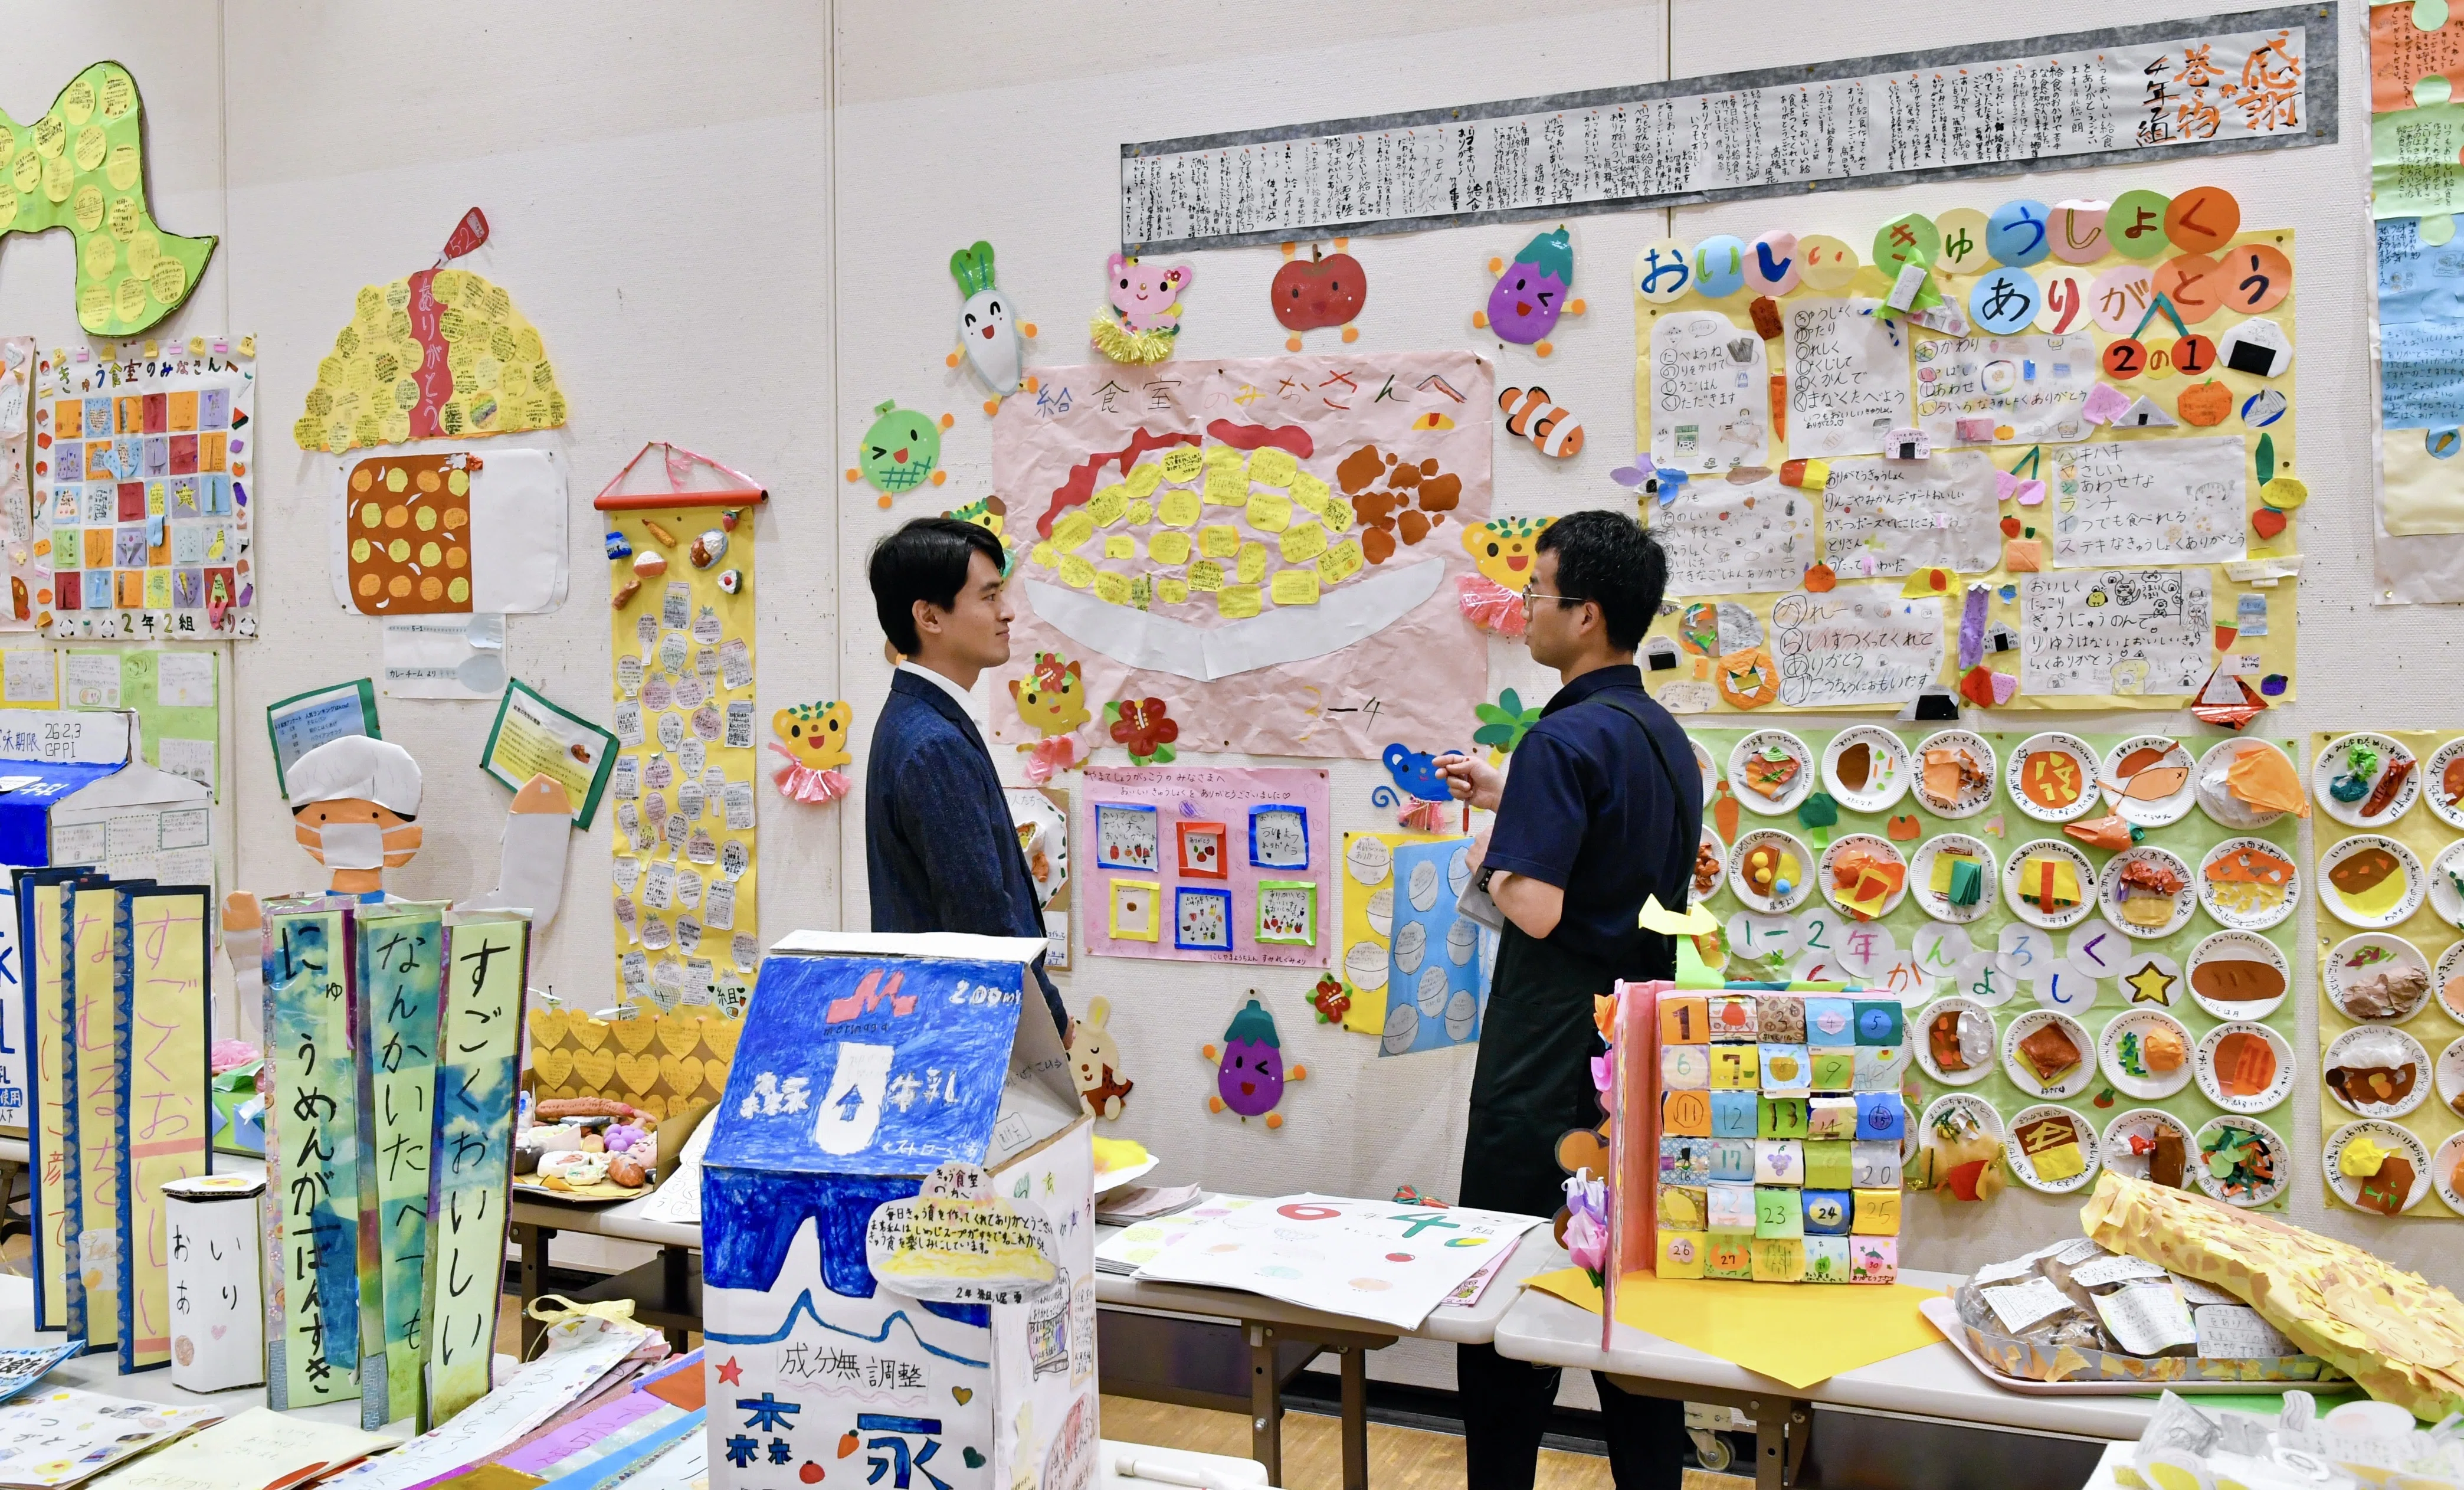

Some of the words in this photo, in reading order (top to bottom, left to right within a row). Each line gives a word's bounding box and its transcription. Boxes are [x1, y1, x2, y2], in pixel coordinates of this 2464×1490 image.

[1641, 241, 1845, 294] おいしい
[1981, 254, 2270, 335] ありがとう
[418, 277, 442, 431] ありがとう
[2112, 339, 2203, 372] 2の1
[58, 359, 239, 393] きゅう食室のみなさんへ
[1036, 369, 1467, 418] 給食室のみなさんへ
[1783, 653, 1865, 678] ありがとう
[0, 727, 41, 752] 味期限
[1871, 1015, 1882, 1031] 5
[1677, 1052, 1690, 1076] 6
[1826, 1061, 1842, 1083] 9
[1722, 1106, 1744, 1130] 12
[443, 938, 512, 1366] すごくおいしい
[1721, 1150, 1742, 1170] 17
[1862, 1165, 1891, 1186] 20
[1764, 1204, 1787, 1225] 23
[1818, 1207, 1838, 1220] 24
[1865, 1200, 1895, 1225] 25
[1673, 1245, 1690, 1256] 26
[1721, 1254, 1737, 1265] 27
[779, 1341, 927, 1390] 成分無調整
